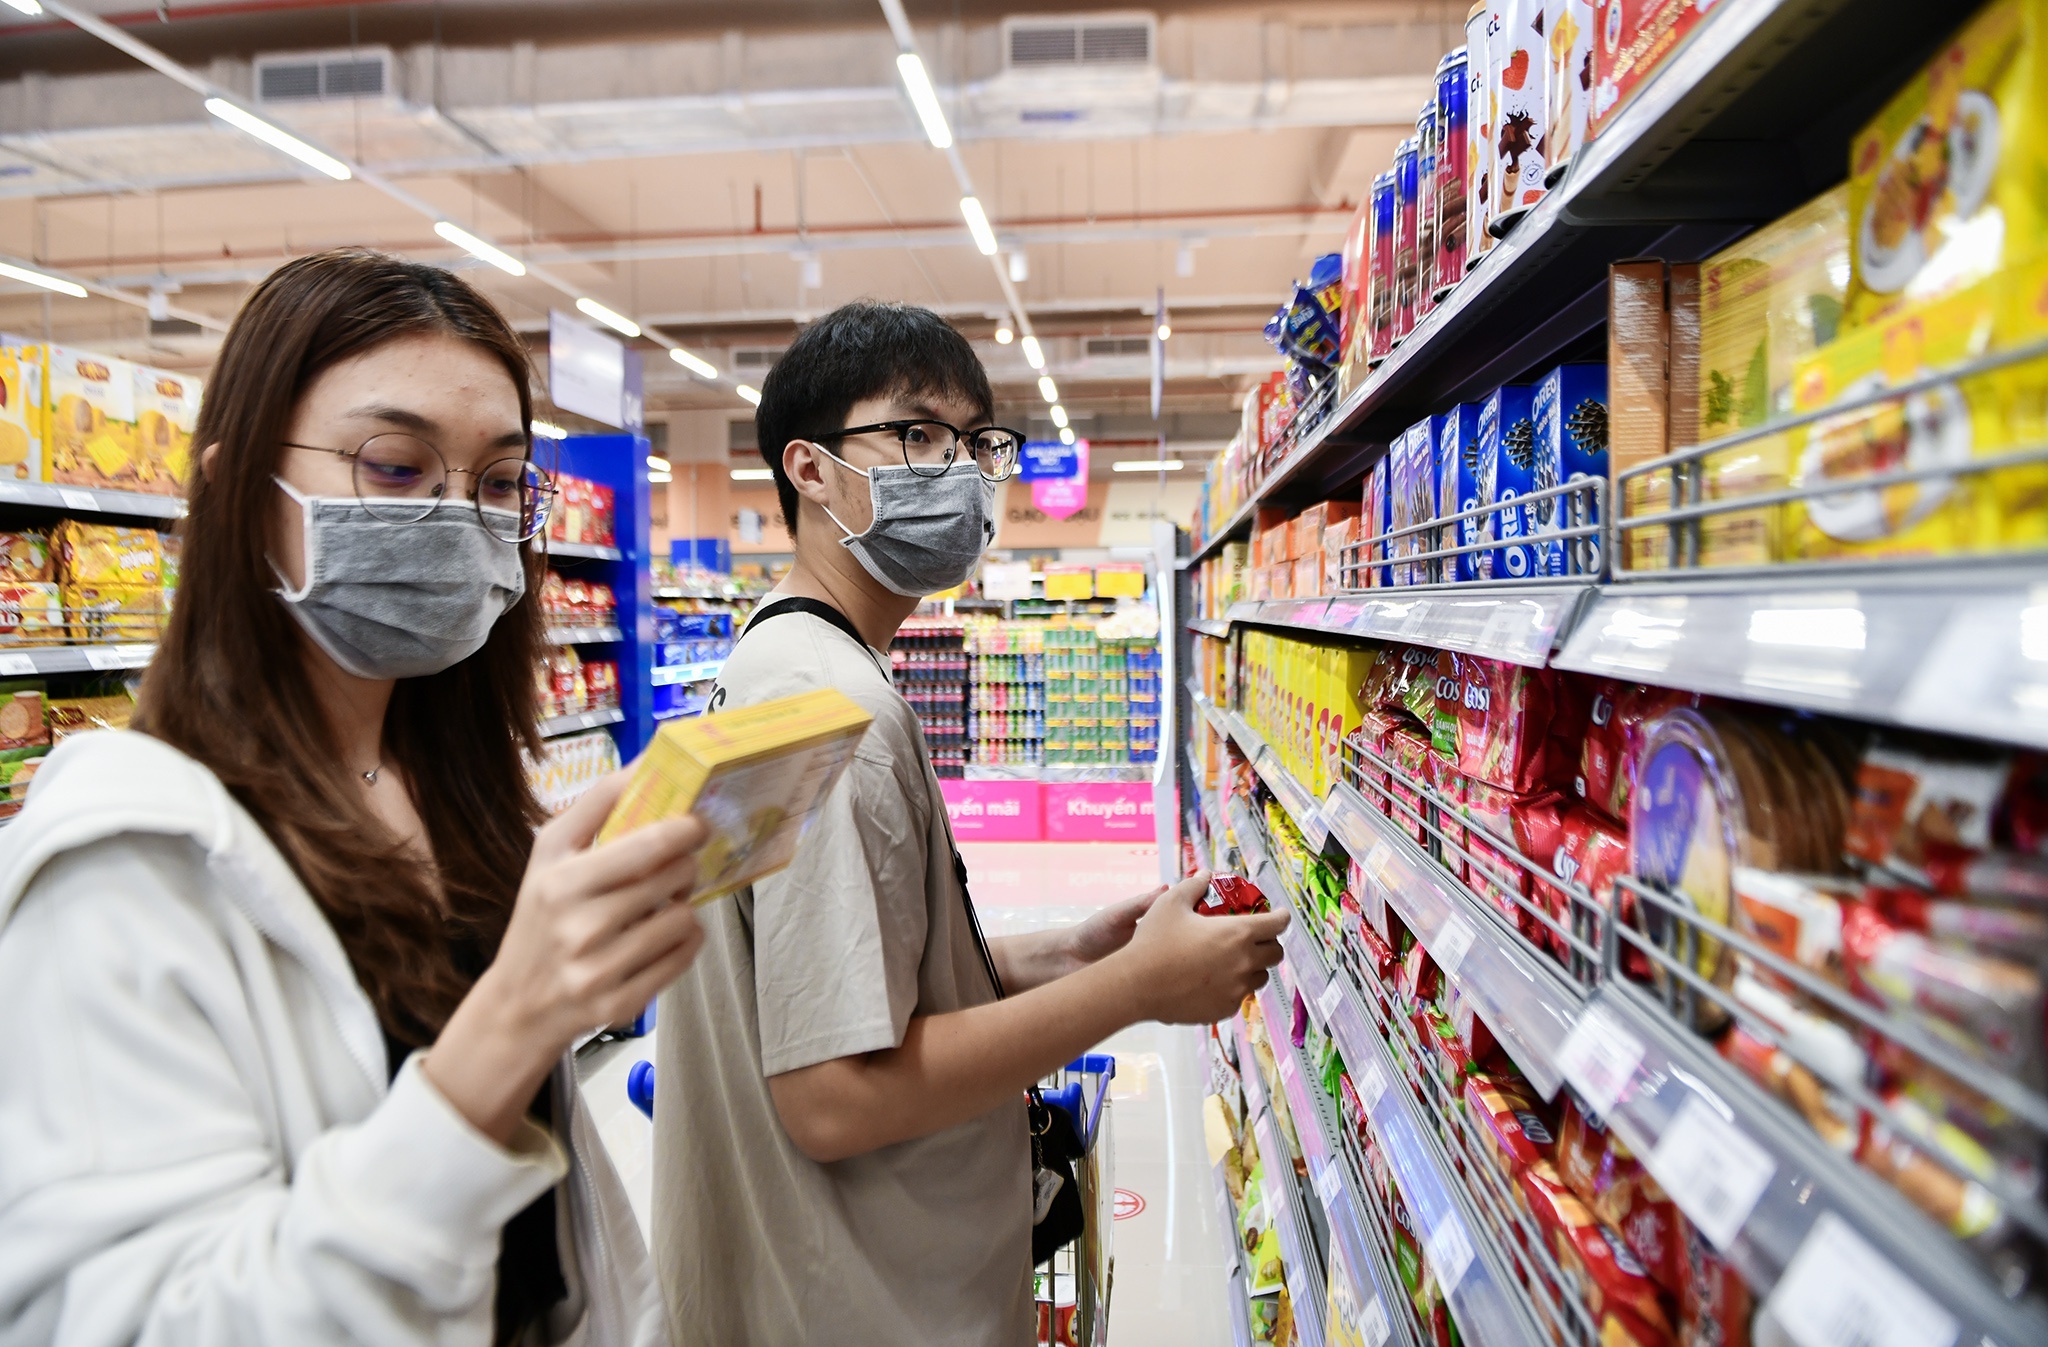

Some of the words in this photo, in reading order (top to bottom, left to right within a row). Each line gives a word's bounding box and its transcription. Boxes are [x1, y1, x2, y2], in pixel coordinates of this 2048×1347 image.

[1531, 377, 1557, 422] OREO
[1477, 397, 1498, 438] OREO
[1501, 488, 1527, 577] OREO
[1435, 675, 1461, 702] COS
[986, 798, 1020, 817] mãi
[1066, 797, 1137, 819] Khuyến
[1140, 801, 1155, 816] m
